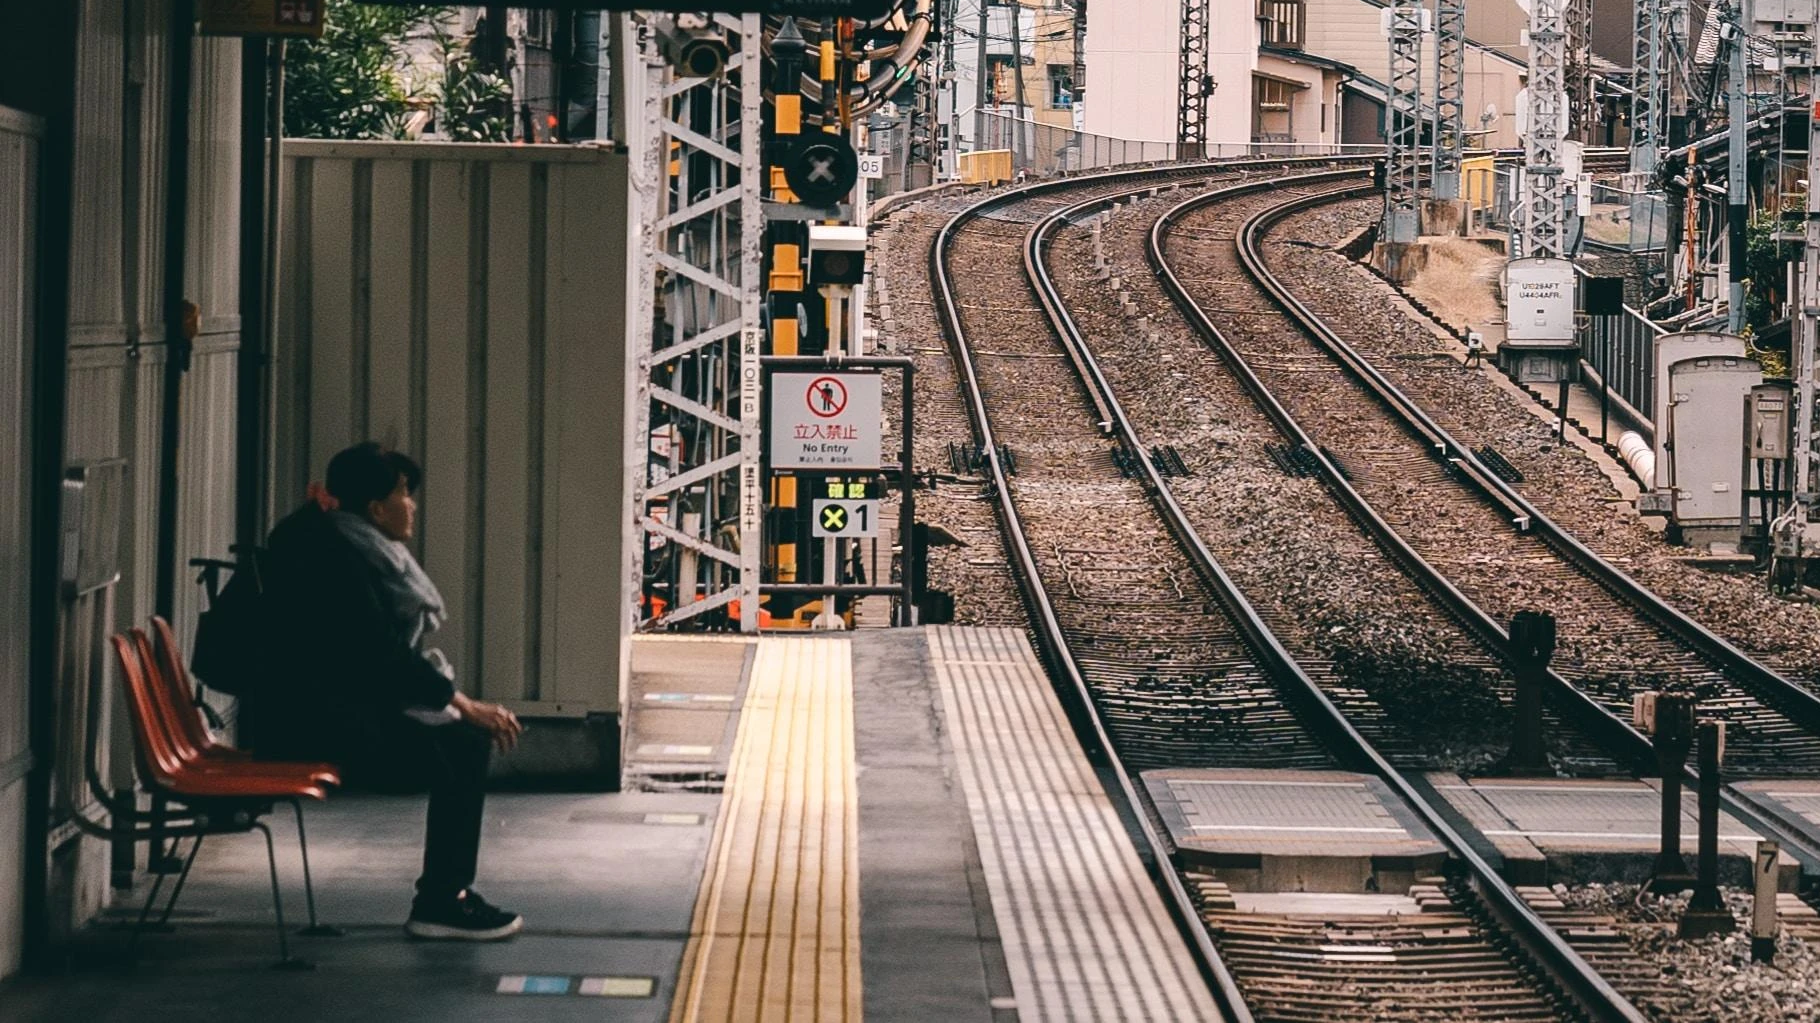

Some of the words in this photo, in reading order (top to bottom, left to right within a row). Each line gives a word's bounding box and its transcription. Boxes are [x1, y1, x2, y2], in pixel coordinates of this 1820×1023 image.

[793, 424, 858, 440] 立入禁止
[803, 443, 818, 453] No
[821, 443, 849, 455] Entry
[855, 504, 868, 531] 1
[1760, 850, 1777, 874] 7
